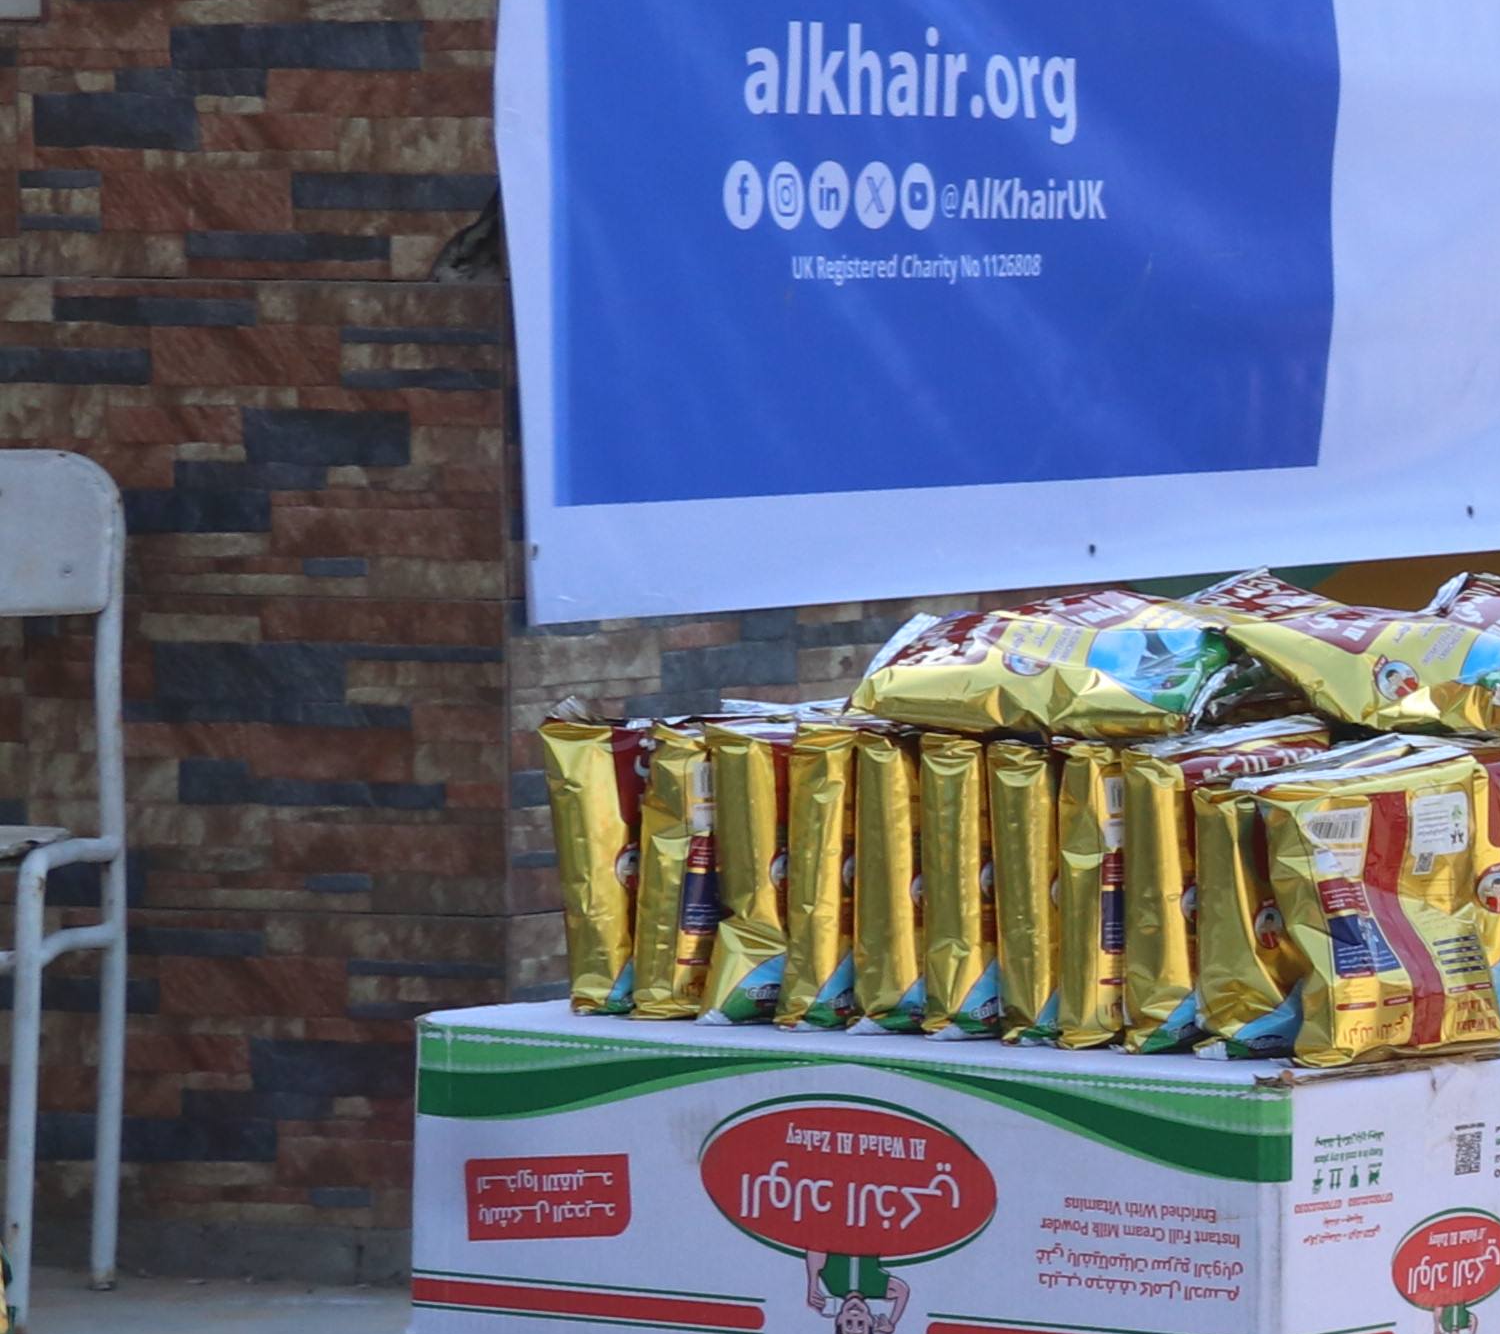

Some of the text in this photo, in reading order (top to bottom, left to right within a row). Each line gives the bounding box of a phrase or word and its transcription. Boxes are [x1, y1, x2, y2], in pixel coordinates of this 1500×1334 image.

[743, 22, 1078, 143] alkhair.org
[941, 178, 1107, 220] @AlKhairUK
[792, 253, 1042, 286] UK Registered Charity No 1126808
[786, 1122, 927, 1161] Al Walad Al Zakey
[476, 1170, 614, 1195] احذروا التقليد
[741, 1161, 960, 1229] الولد الذكي
[478, 1200, 616, 1228] بالشكل الجديد
[1064, 1196, 1217, 1223] Enriched With Vitamins
[1040, 1218, 1240, 1248] Instant Full Cream Milk Powder
[1035, 1242, 1244, 1280] غني بالفيتامينات سريع الذوبان
[1407, 1238, 1500, 1294] الولد الذكي
[1039, 1270, 1241, 1302] حليب مجفف كامل الدسم
